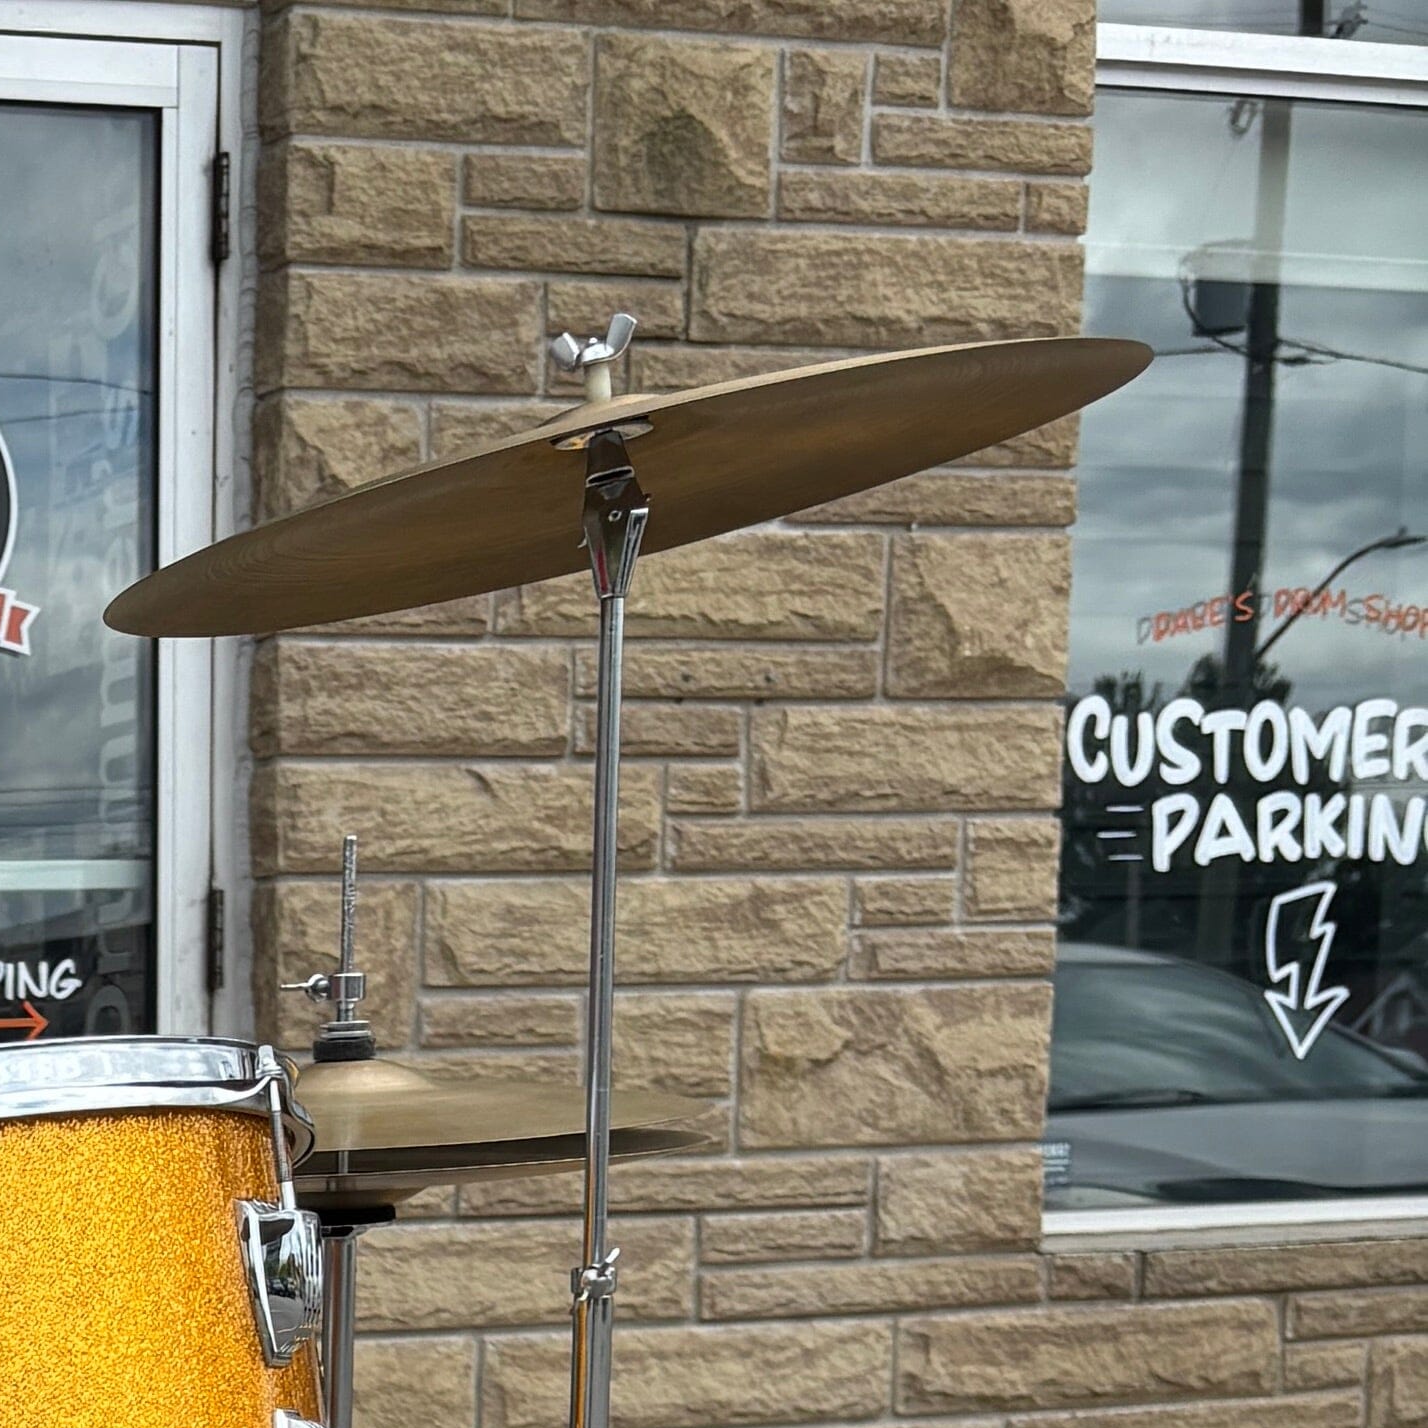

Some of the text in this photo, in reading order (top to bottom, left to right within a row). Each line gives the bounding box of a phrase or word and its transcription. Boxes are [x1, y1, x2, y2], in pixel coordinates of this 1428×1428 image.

[1152, 589, 1255, 643] DAVE'S
[1273, 587, 1347, 620] DRUM
[1067, 694, 1428, 787] CUSTOMER
[1152, 791, 1428, 873] PARKIN
